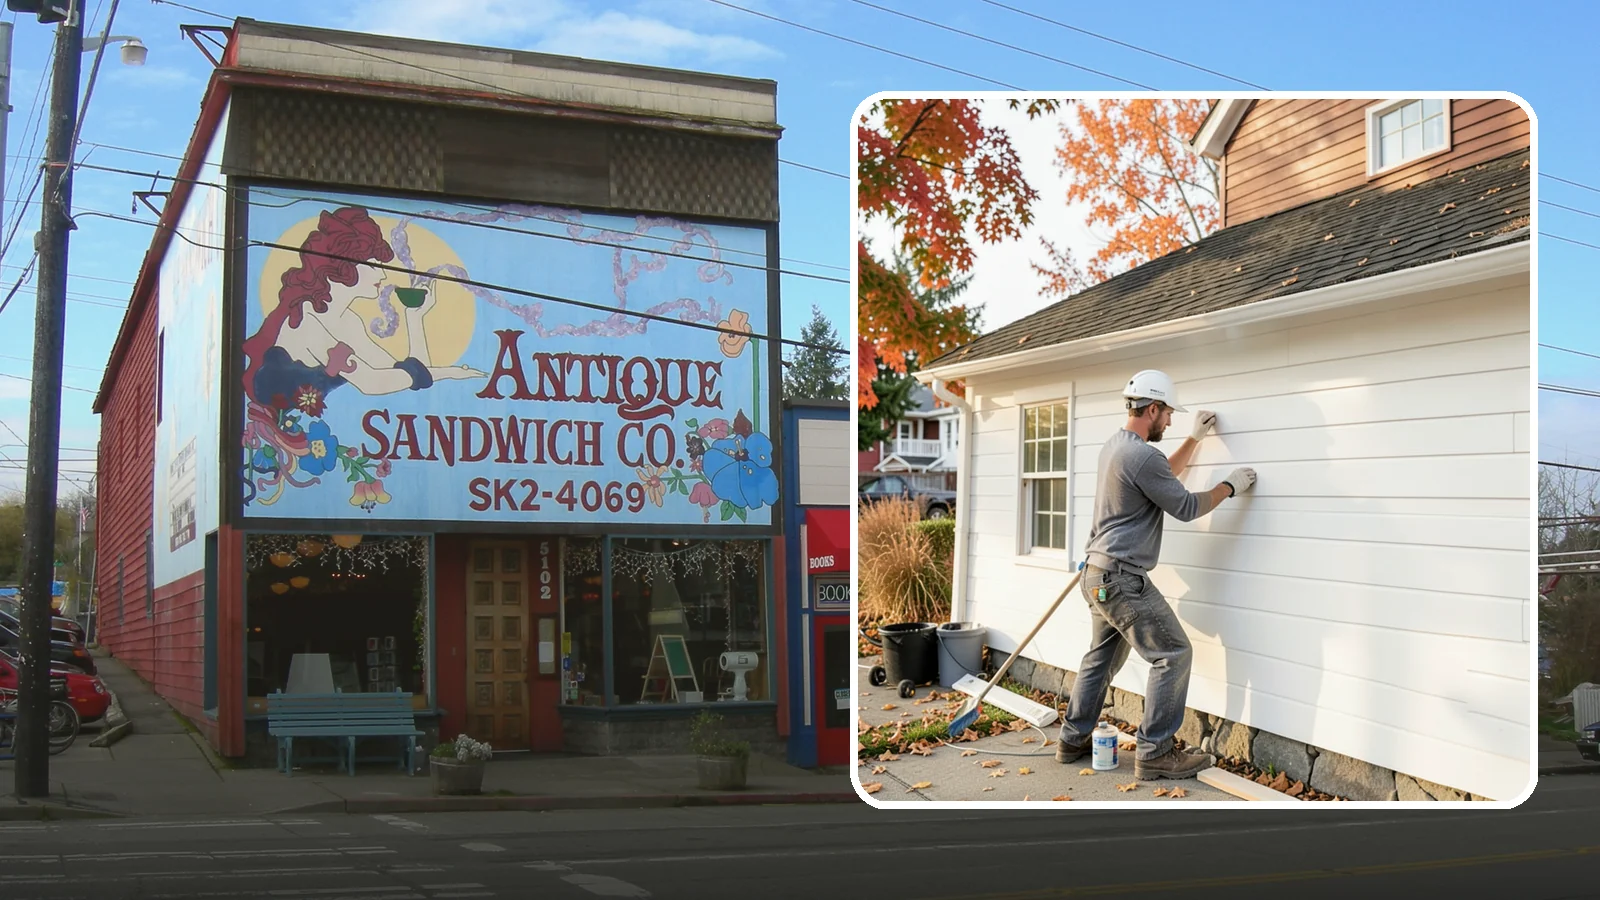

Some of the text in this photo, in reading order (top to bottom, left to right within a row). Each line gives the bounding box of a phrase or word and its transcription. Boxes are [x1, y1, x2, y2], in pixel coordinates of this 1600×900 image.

[475, 329, 723, 421] ANTIQUE
[362, 409, 685, 468] SANDWICH CO.
[468, 477, 645, 513] SK2-4069
[540, 541, 551, 600] 5102
[809, 555, 834, 569] BOOKS
